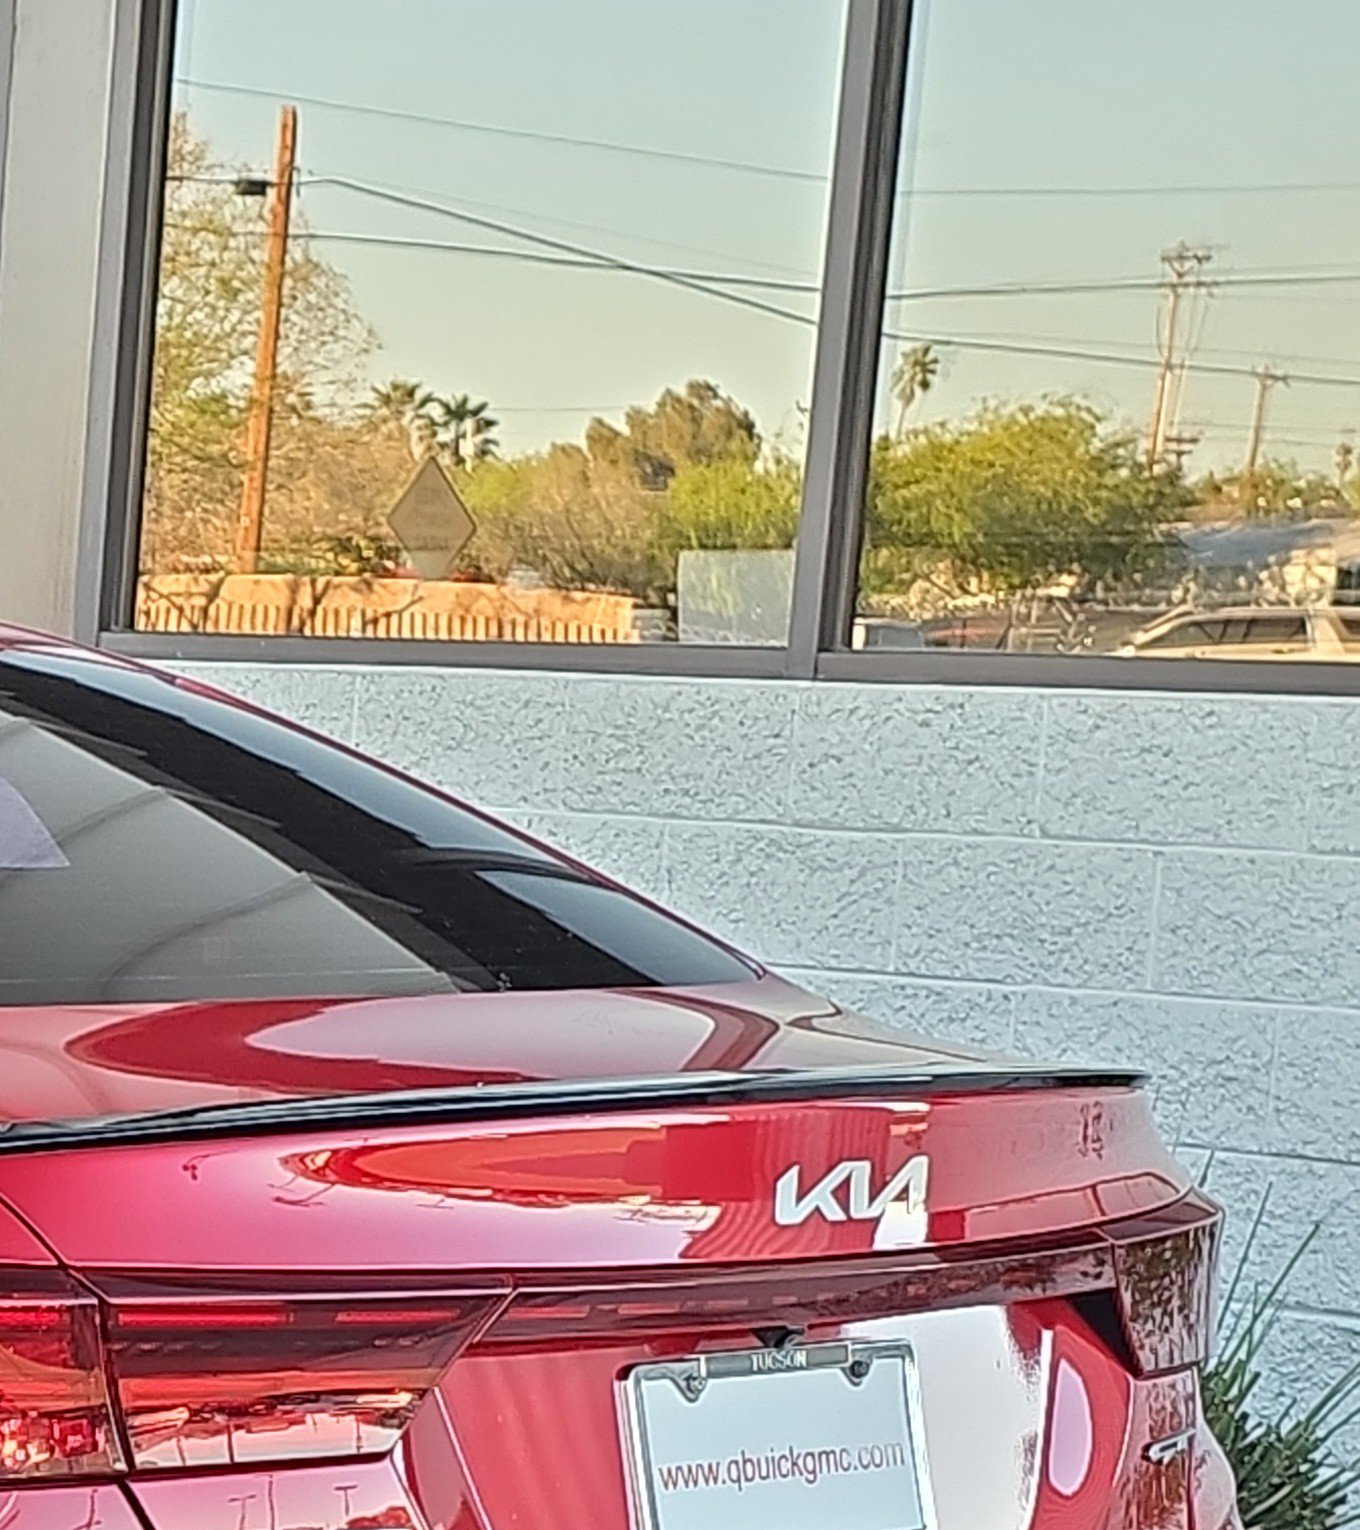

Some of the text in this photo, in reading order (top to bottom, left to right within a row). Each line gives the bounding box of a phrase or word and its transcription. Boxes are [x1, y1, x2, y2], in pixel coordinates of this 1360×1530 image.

[775, 1155, 929, 1225] KIA
[750, 1348, 808, 1372] TUCSON
[657, 1440, 906, 1493] www.qbuickgmc.com
